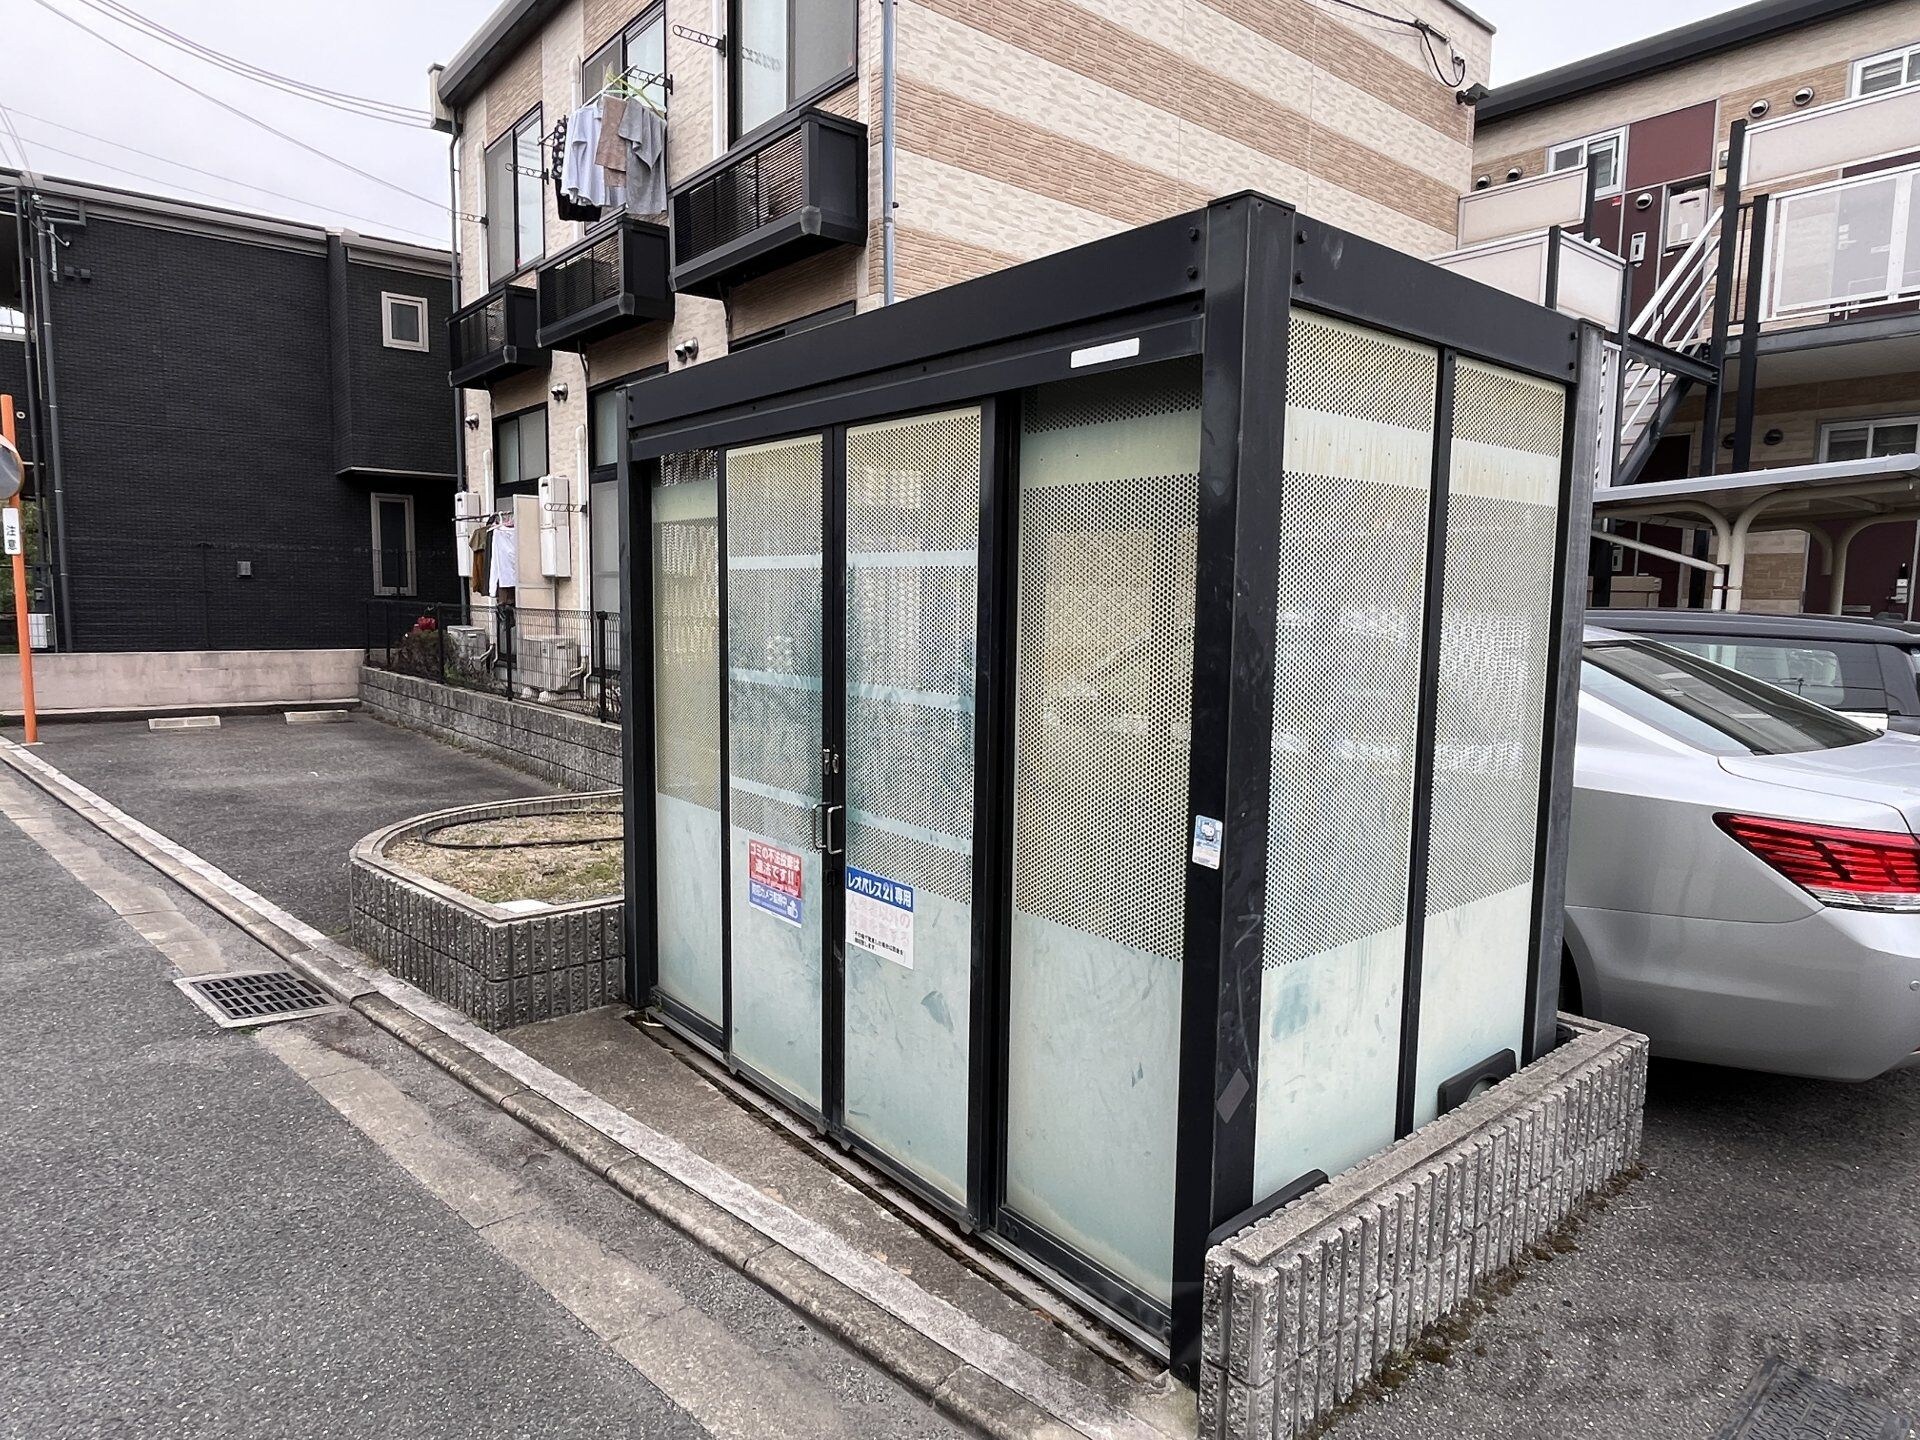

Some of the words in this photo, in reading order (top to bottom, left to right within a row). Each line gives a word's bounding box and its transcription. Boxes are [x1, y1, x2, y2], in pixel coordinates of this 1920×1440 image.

[6, 524, 18, 551] 注意
[750, 842, 800, 871] ゴミの不法投棄は
